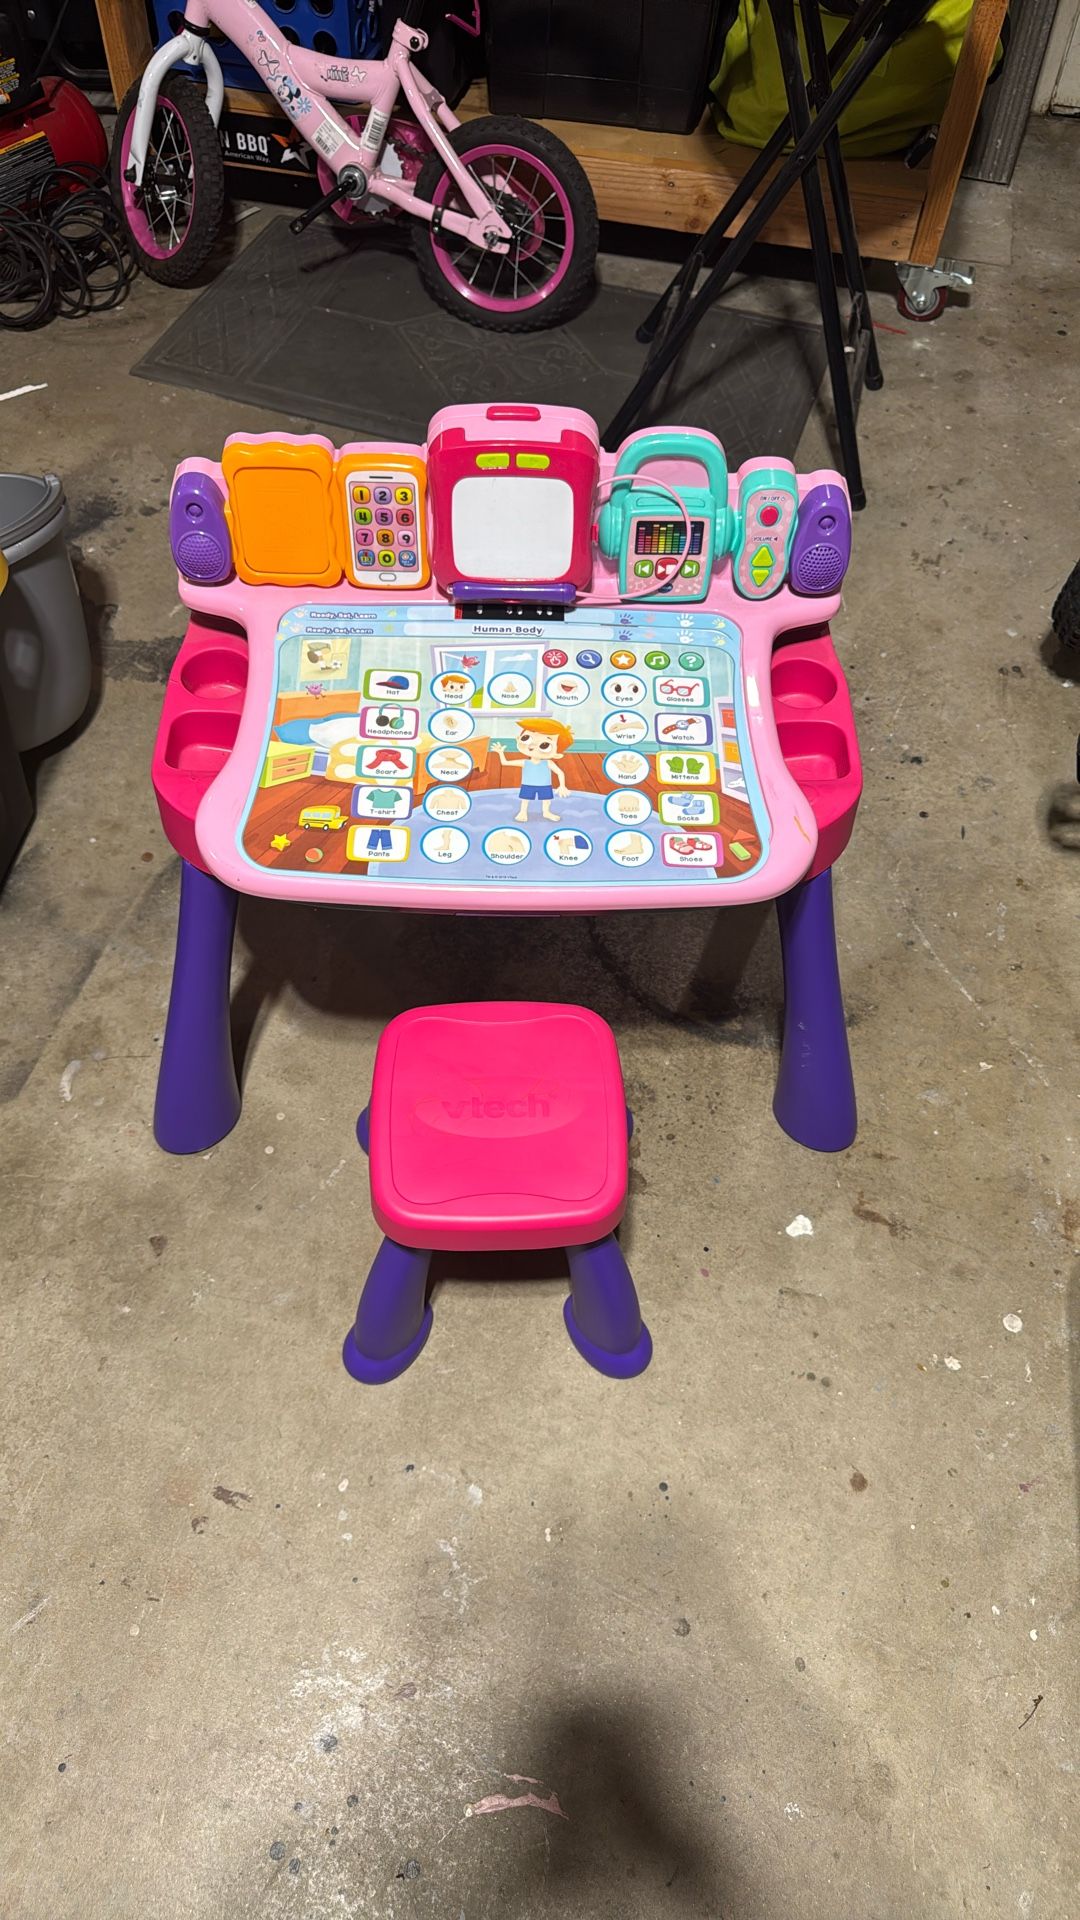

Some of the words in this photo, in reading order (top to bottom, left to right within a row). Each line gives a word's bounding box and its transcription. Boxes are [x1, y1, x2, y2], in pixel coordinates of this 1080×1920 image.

[236, 132, 268, 156] BBQ
[224, 150, 255, 161] American
[359, 490, 364, 500] 1
[378, 491, 388, 501] 2
[399, 491, 409, 502] 3
[359, 511, 368, 522] 4
[380, 512, 389, 522] 5
[401, 513, 410, 523] 6
[361, 533, 369, 543] 7
[381, 533, 390, 544] 8
[402, 534, 411, 544] 9
[382, 553, 392, 563] 0
[473, 625, 512, 633] Human
[515, 626, 544, 635] Body
[441, 1093, 550, 1119] vtech
